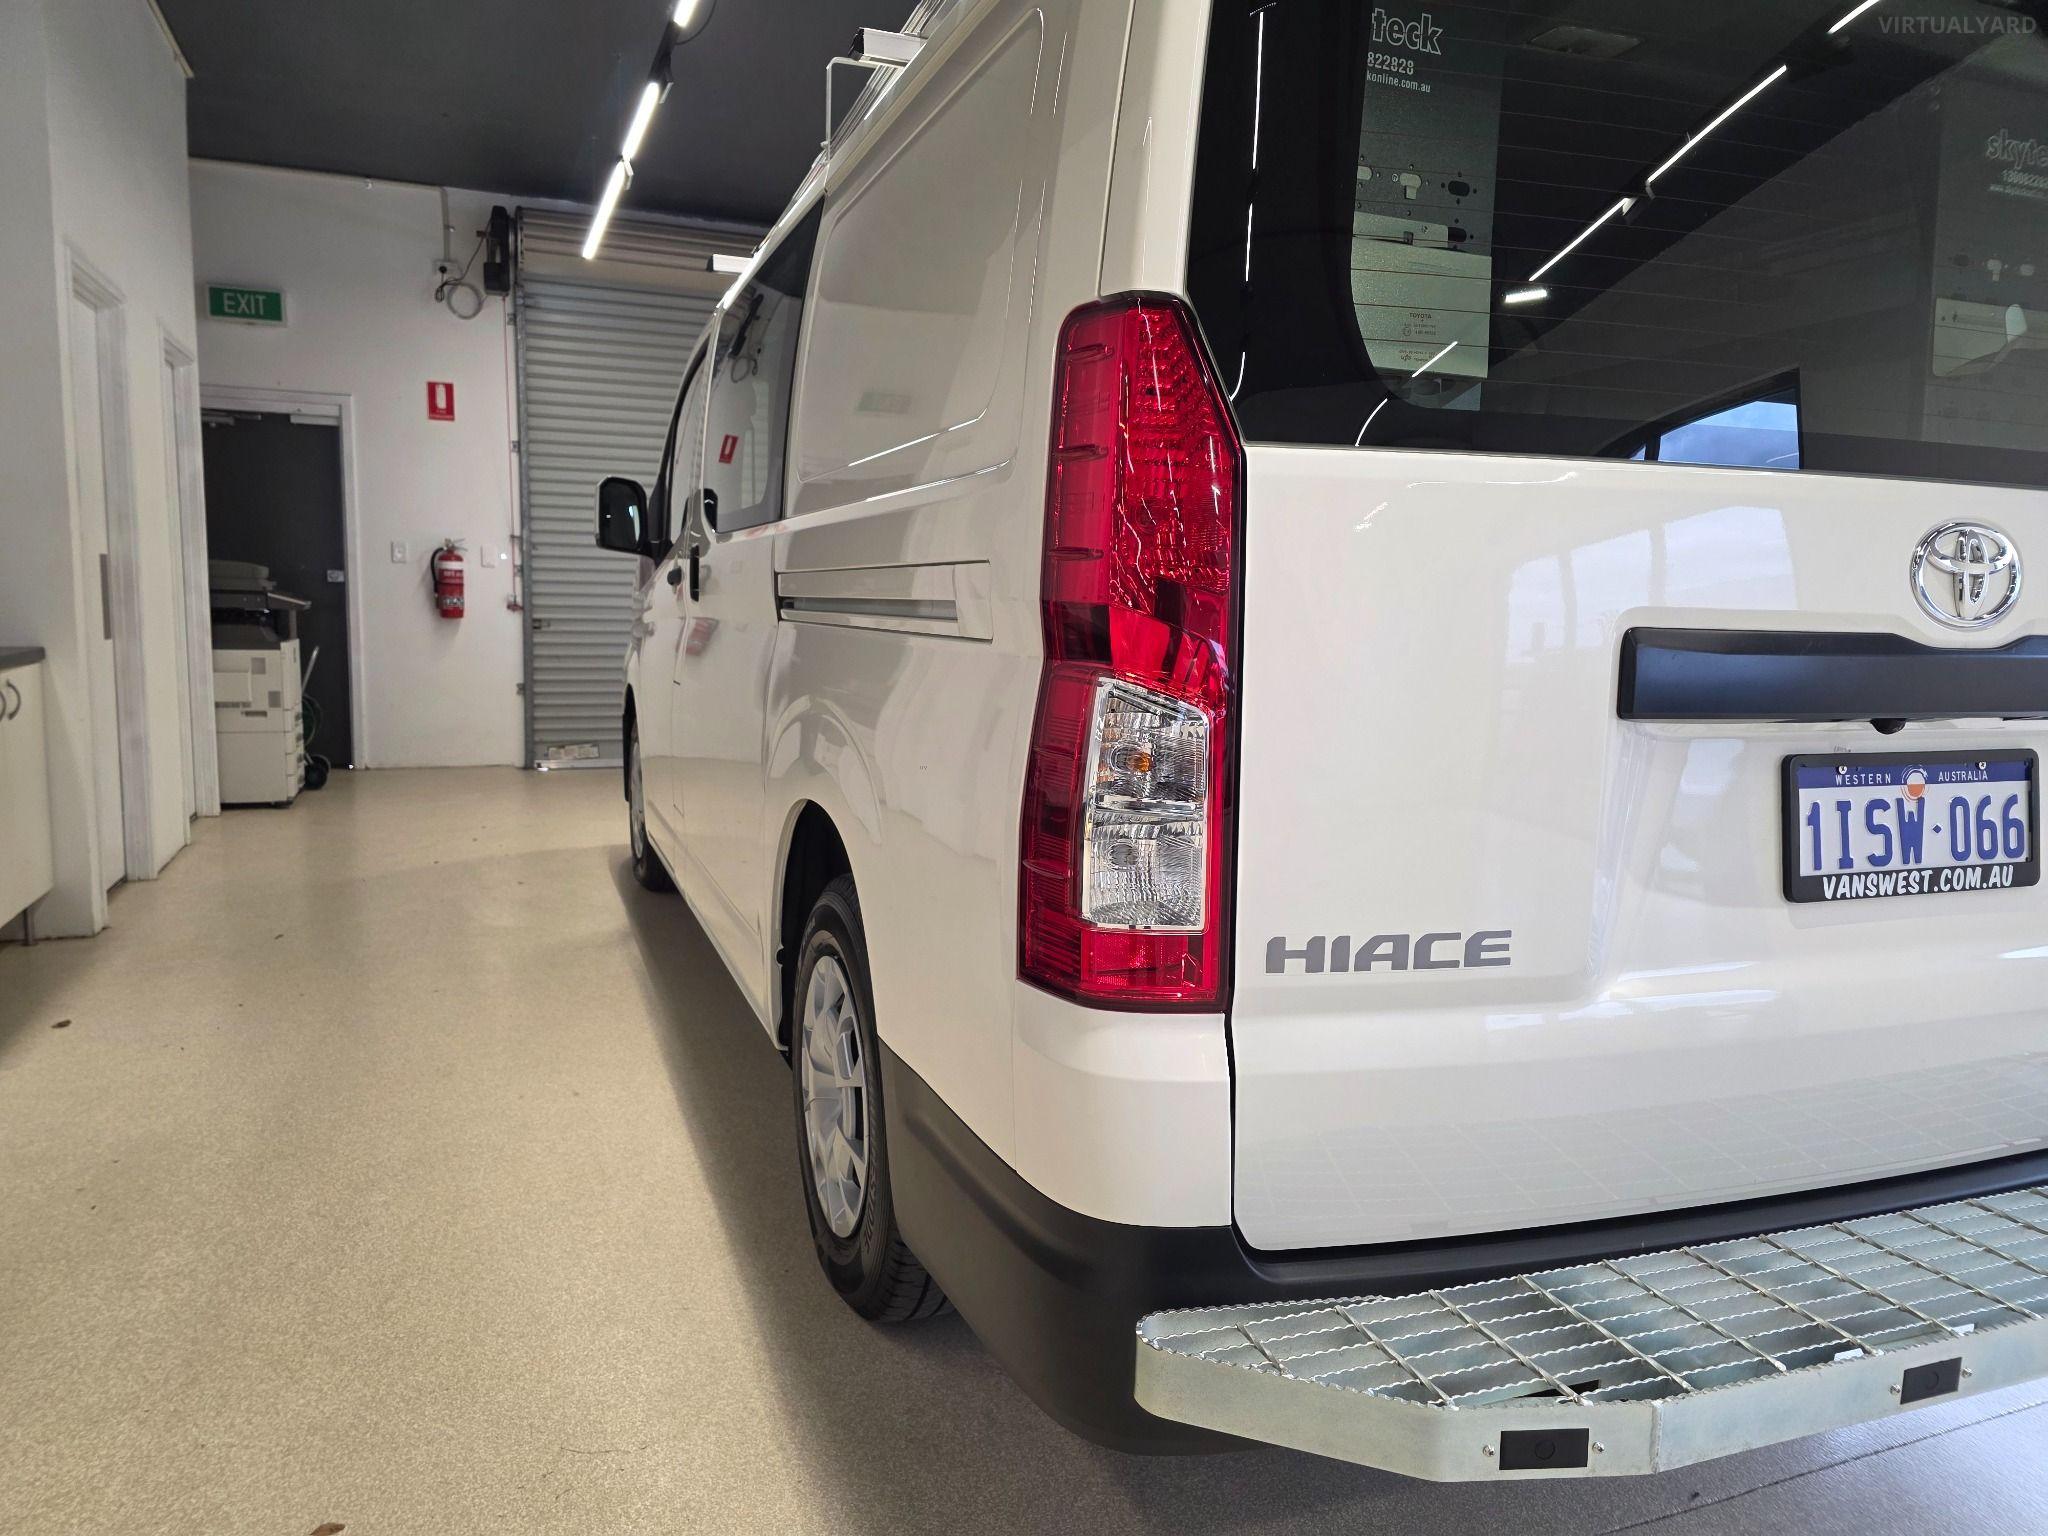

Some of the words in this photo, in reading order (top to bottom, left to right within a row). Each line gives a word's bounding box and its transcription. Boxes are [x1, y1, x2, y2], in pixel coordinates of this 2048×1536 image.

[223, 292, 267, 316] EXIT
[1835, 773, 1891, 785] WESTERN
[1938, 770, 1988, 782] AUSTRALIA
[1823, 864, 2014, 900] VANSWEST.COM.AU
[1265, 930, 1512, 974] HIACE
